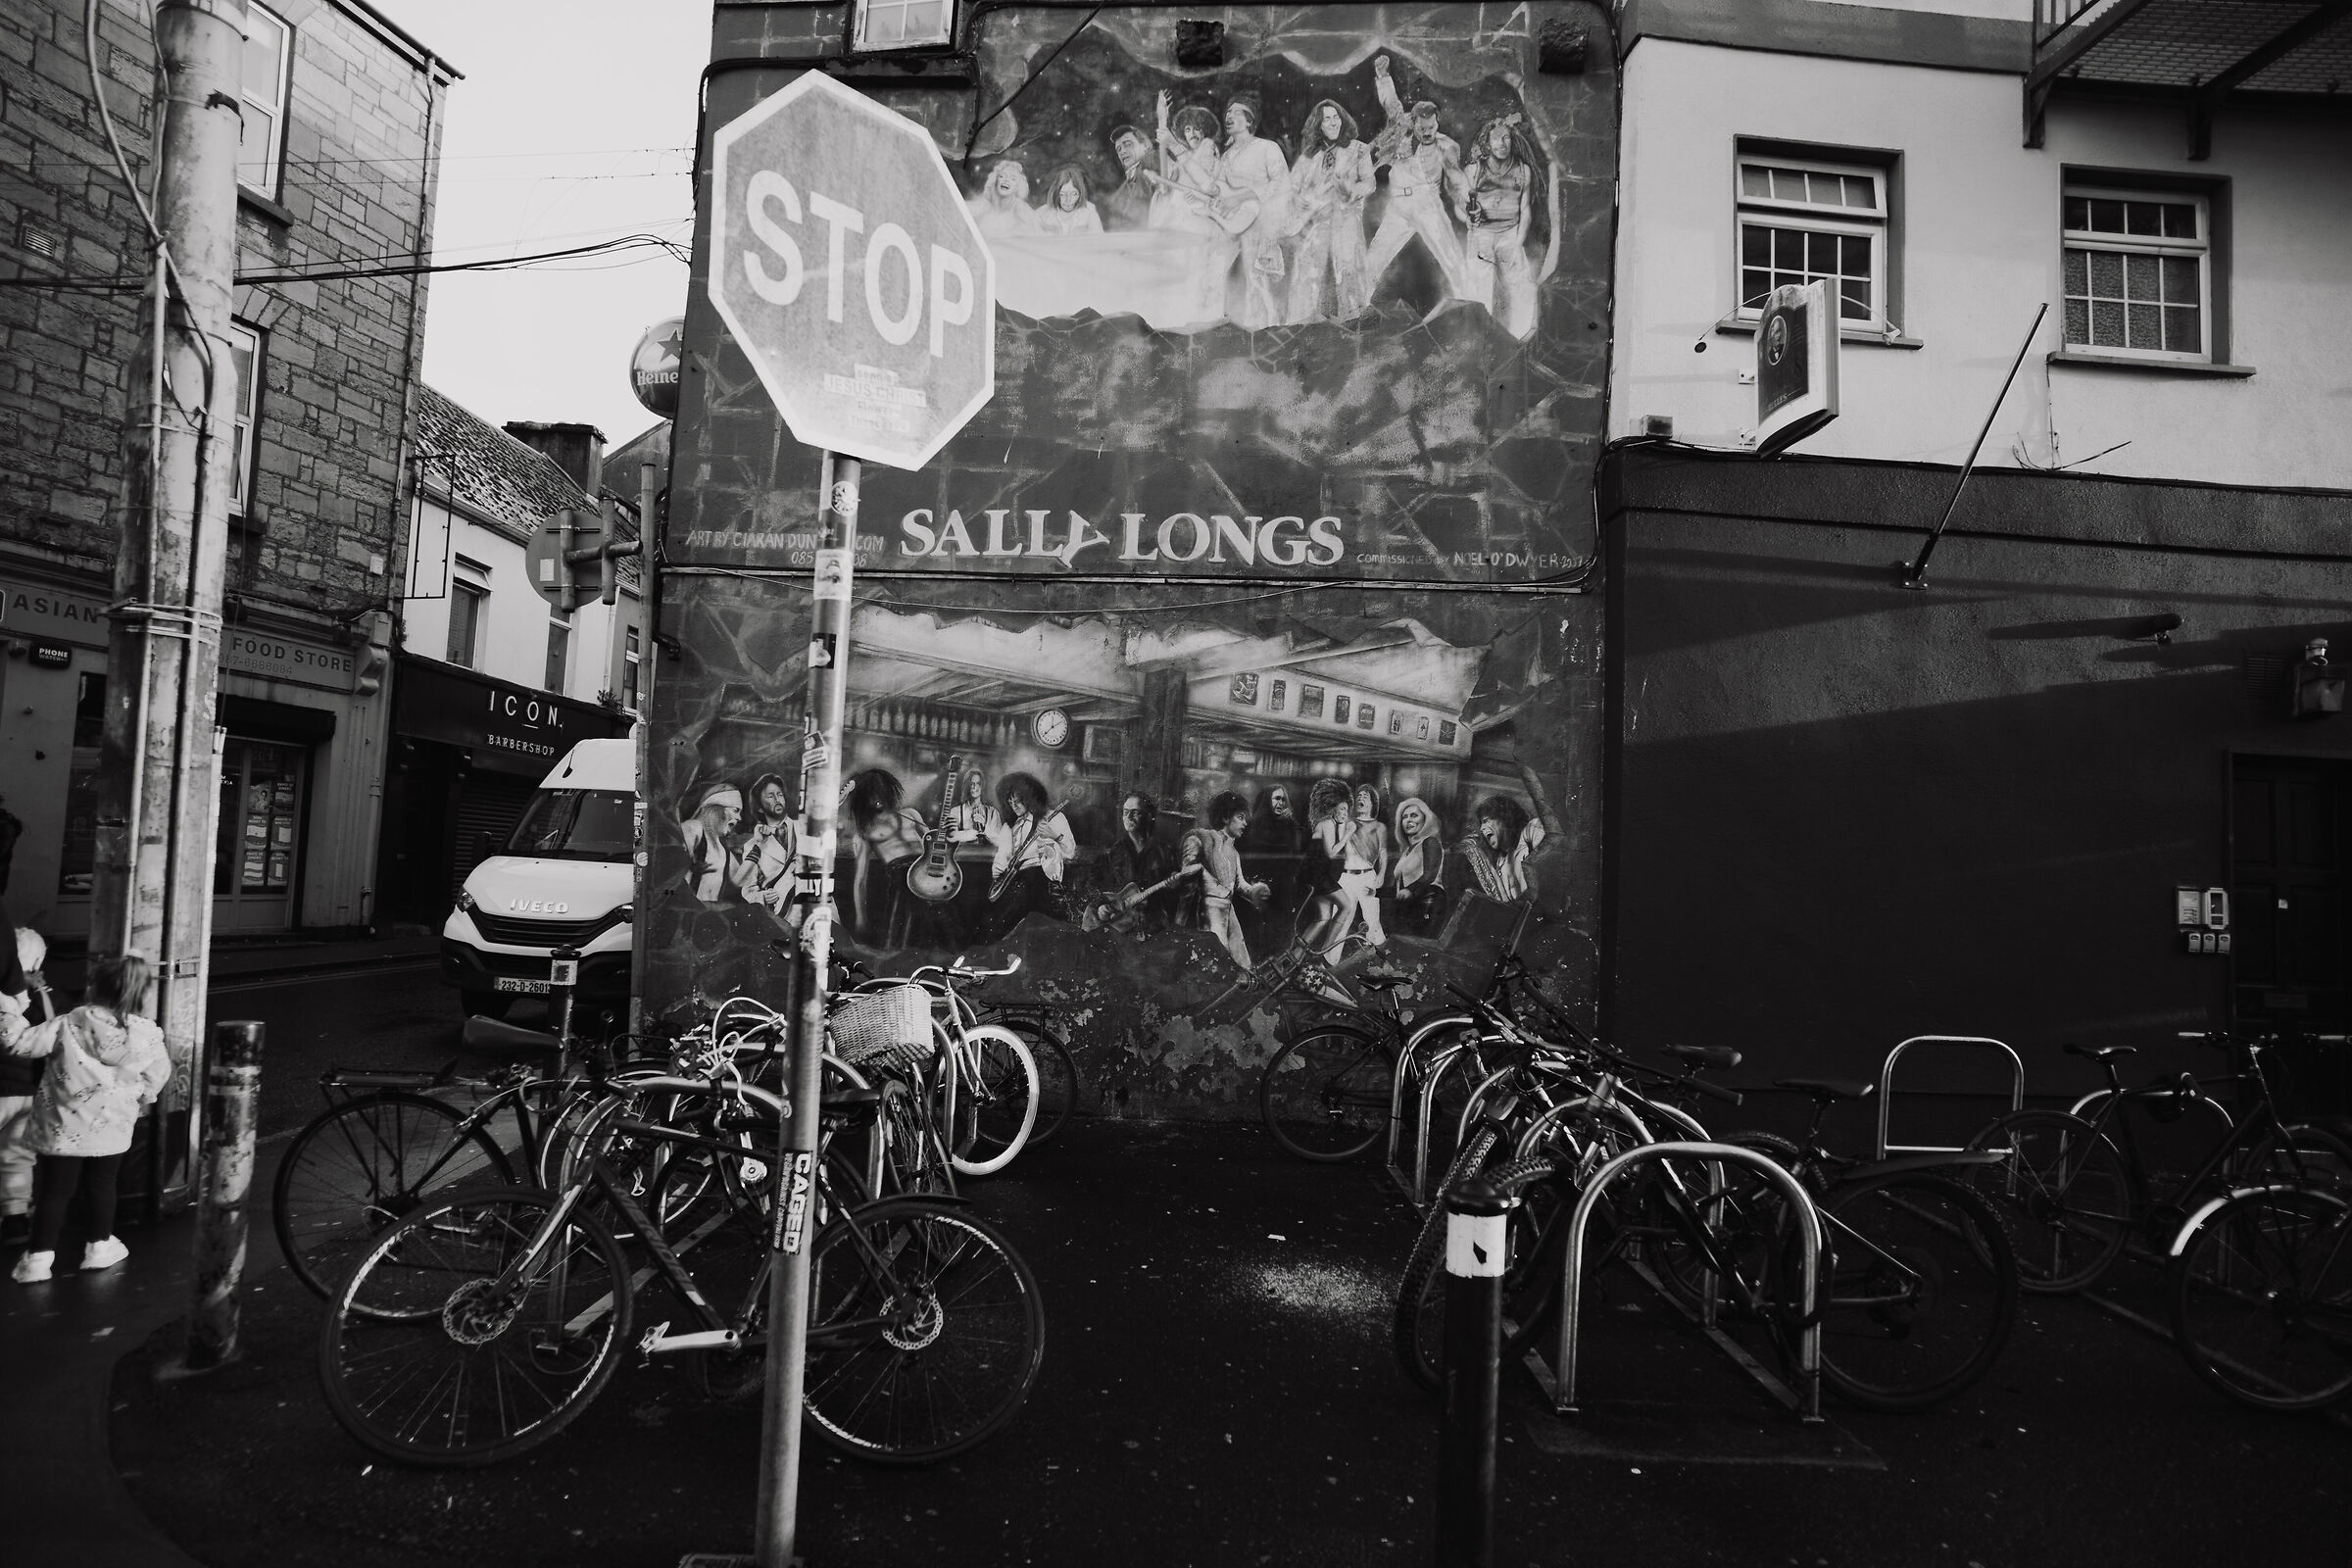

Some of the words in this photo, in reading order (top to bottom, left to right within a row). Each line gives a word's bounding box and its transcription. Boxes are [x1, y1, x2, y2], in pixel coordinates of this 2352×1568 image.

[743, 170, 975, 358] STOP
[637, 370, 680, 386] Heine
[685, 530, 712, 547] ART
[899, 508, 1111, 568] SALLY
[1117, 512, 1346, 566] LONGS
[13, 594, 99, 623] ASIAN
[232, 637, 286, 660] FOOD
[294, 649, 351, 673] STORE
[38, 648, 70, 659] PHONE
[488, 734, 556, 756] BARBERSHOP
[510, 899, 569, 914] IVECO
[783, 1153, 811, 1252] CAGED
